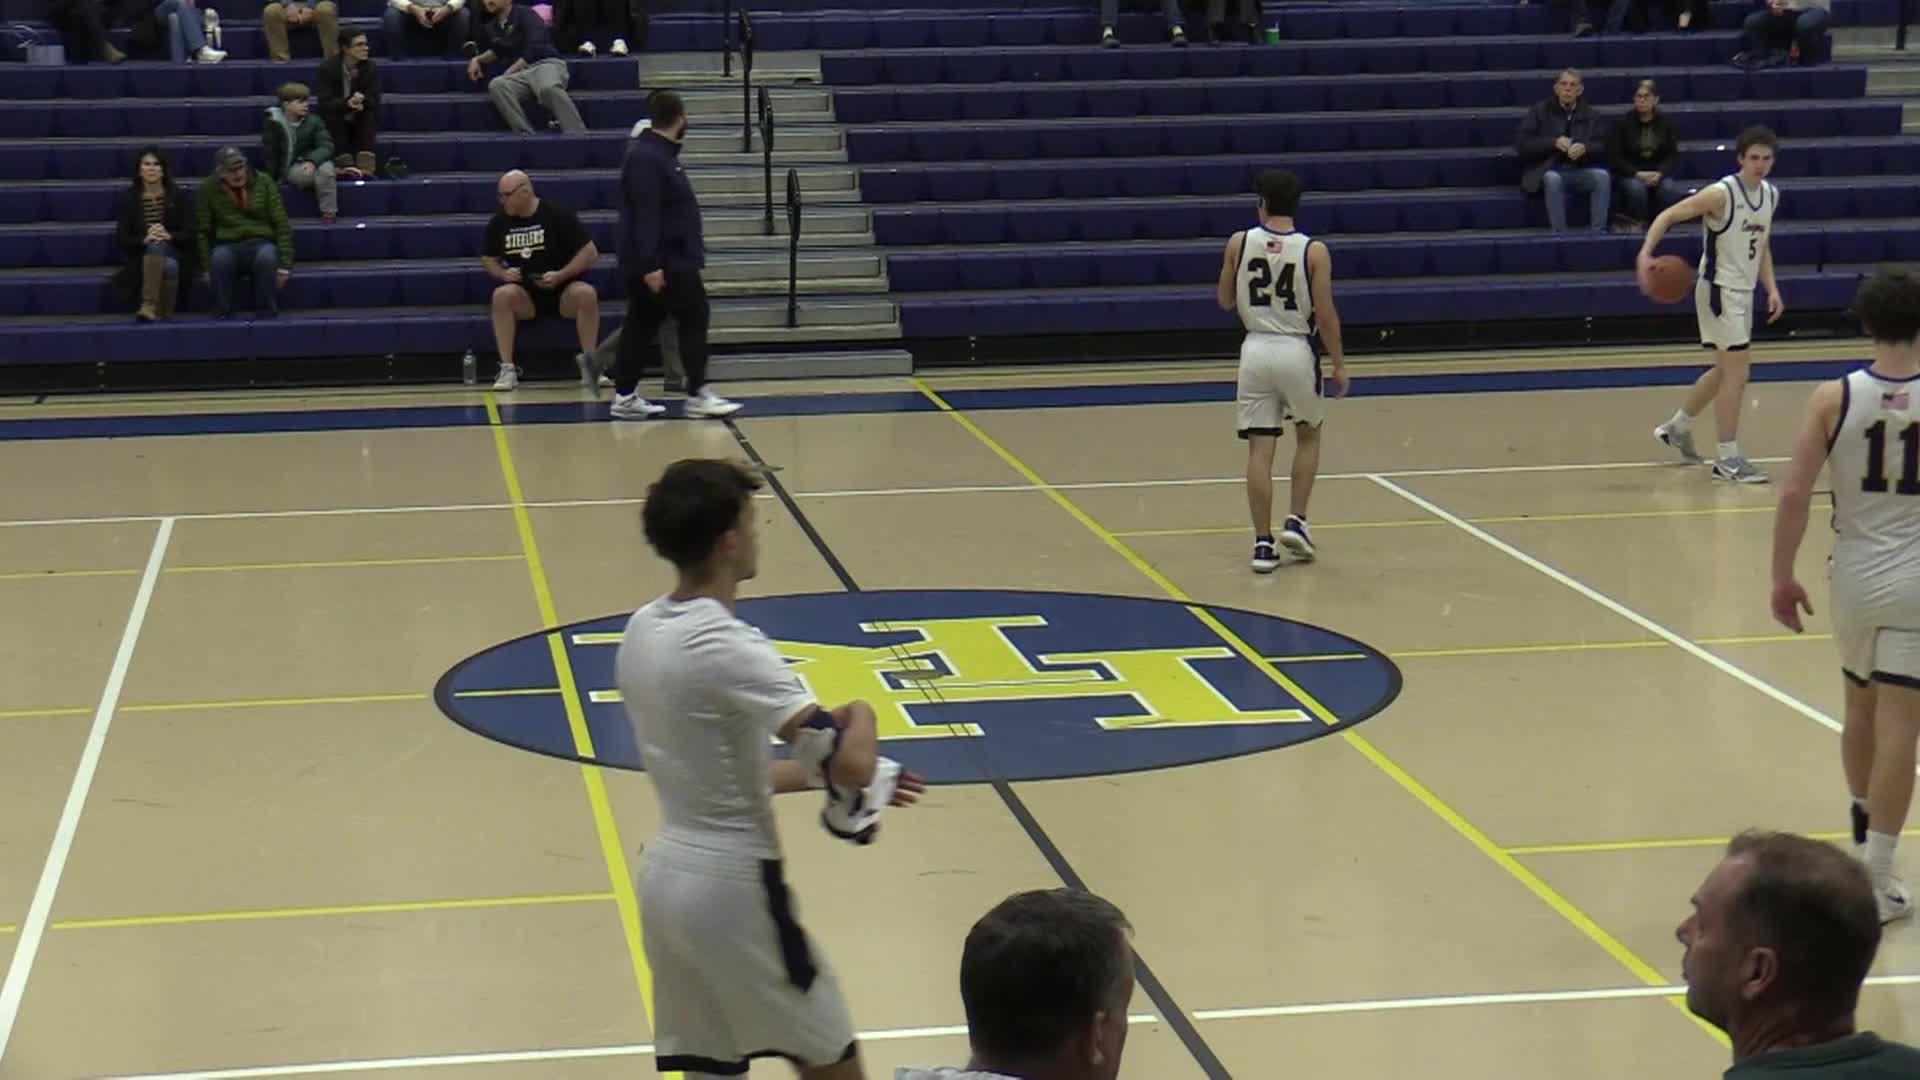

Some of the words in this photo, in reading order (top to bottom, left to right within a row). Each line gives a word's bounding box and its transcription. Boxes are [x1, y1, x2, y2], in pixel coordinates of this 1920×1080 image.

[505, 230, 545, 249] STEELERS
[1748, 238, 1757, 261] 5
[1247, 257, 1299, 311] 24
[1861, 419, 1920, 495] 11
